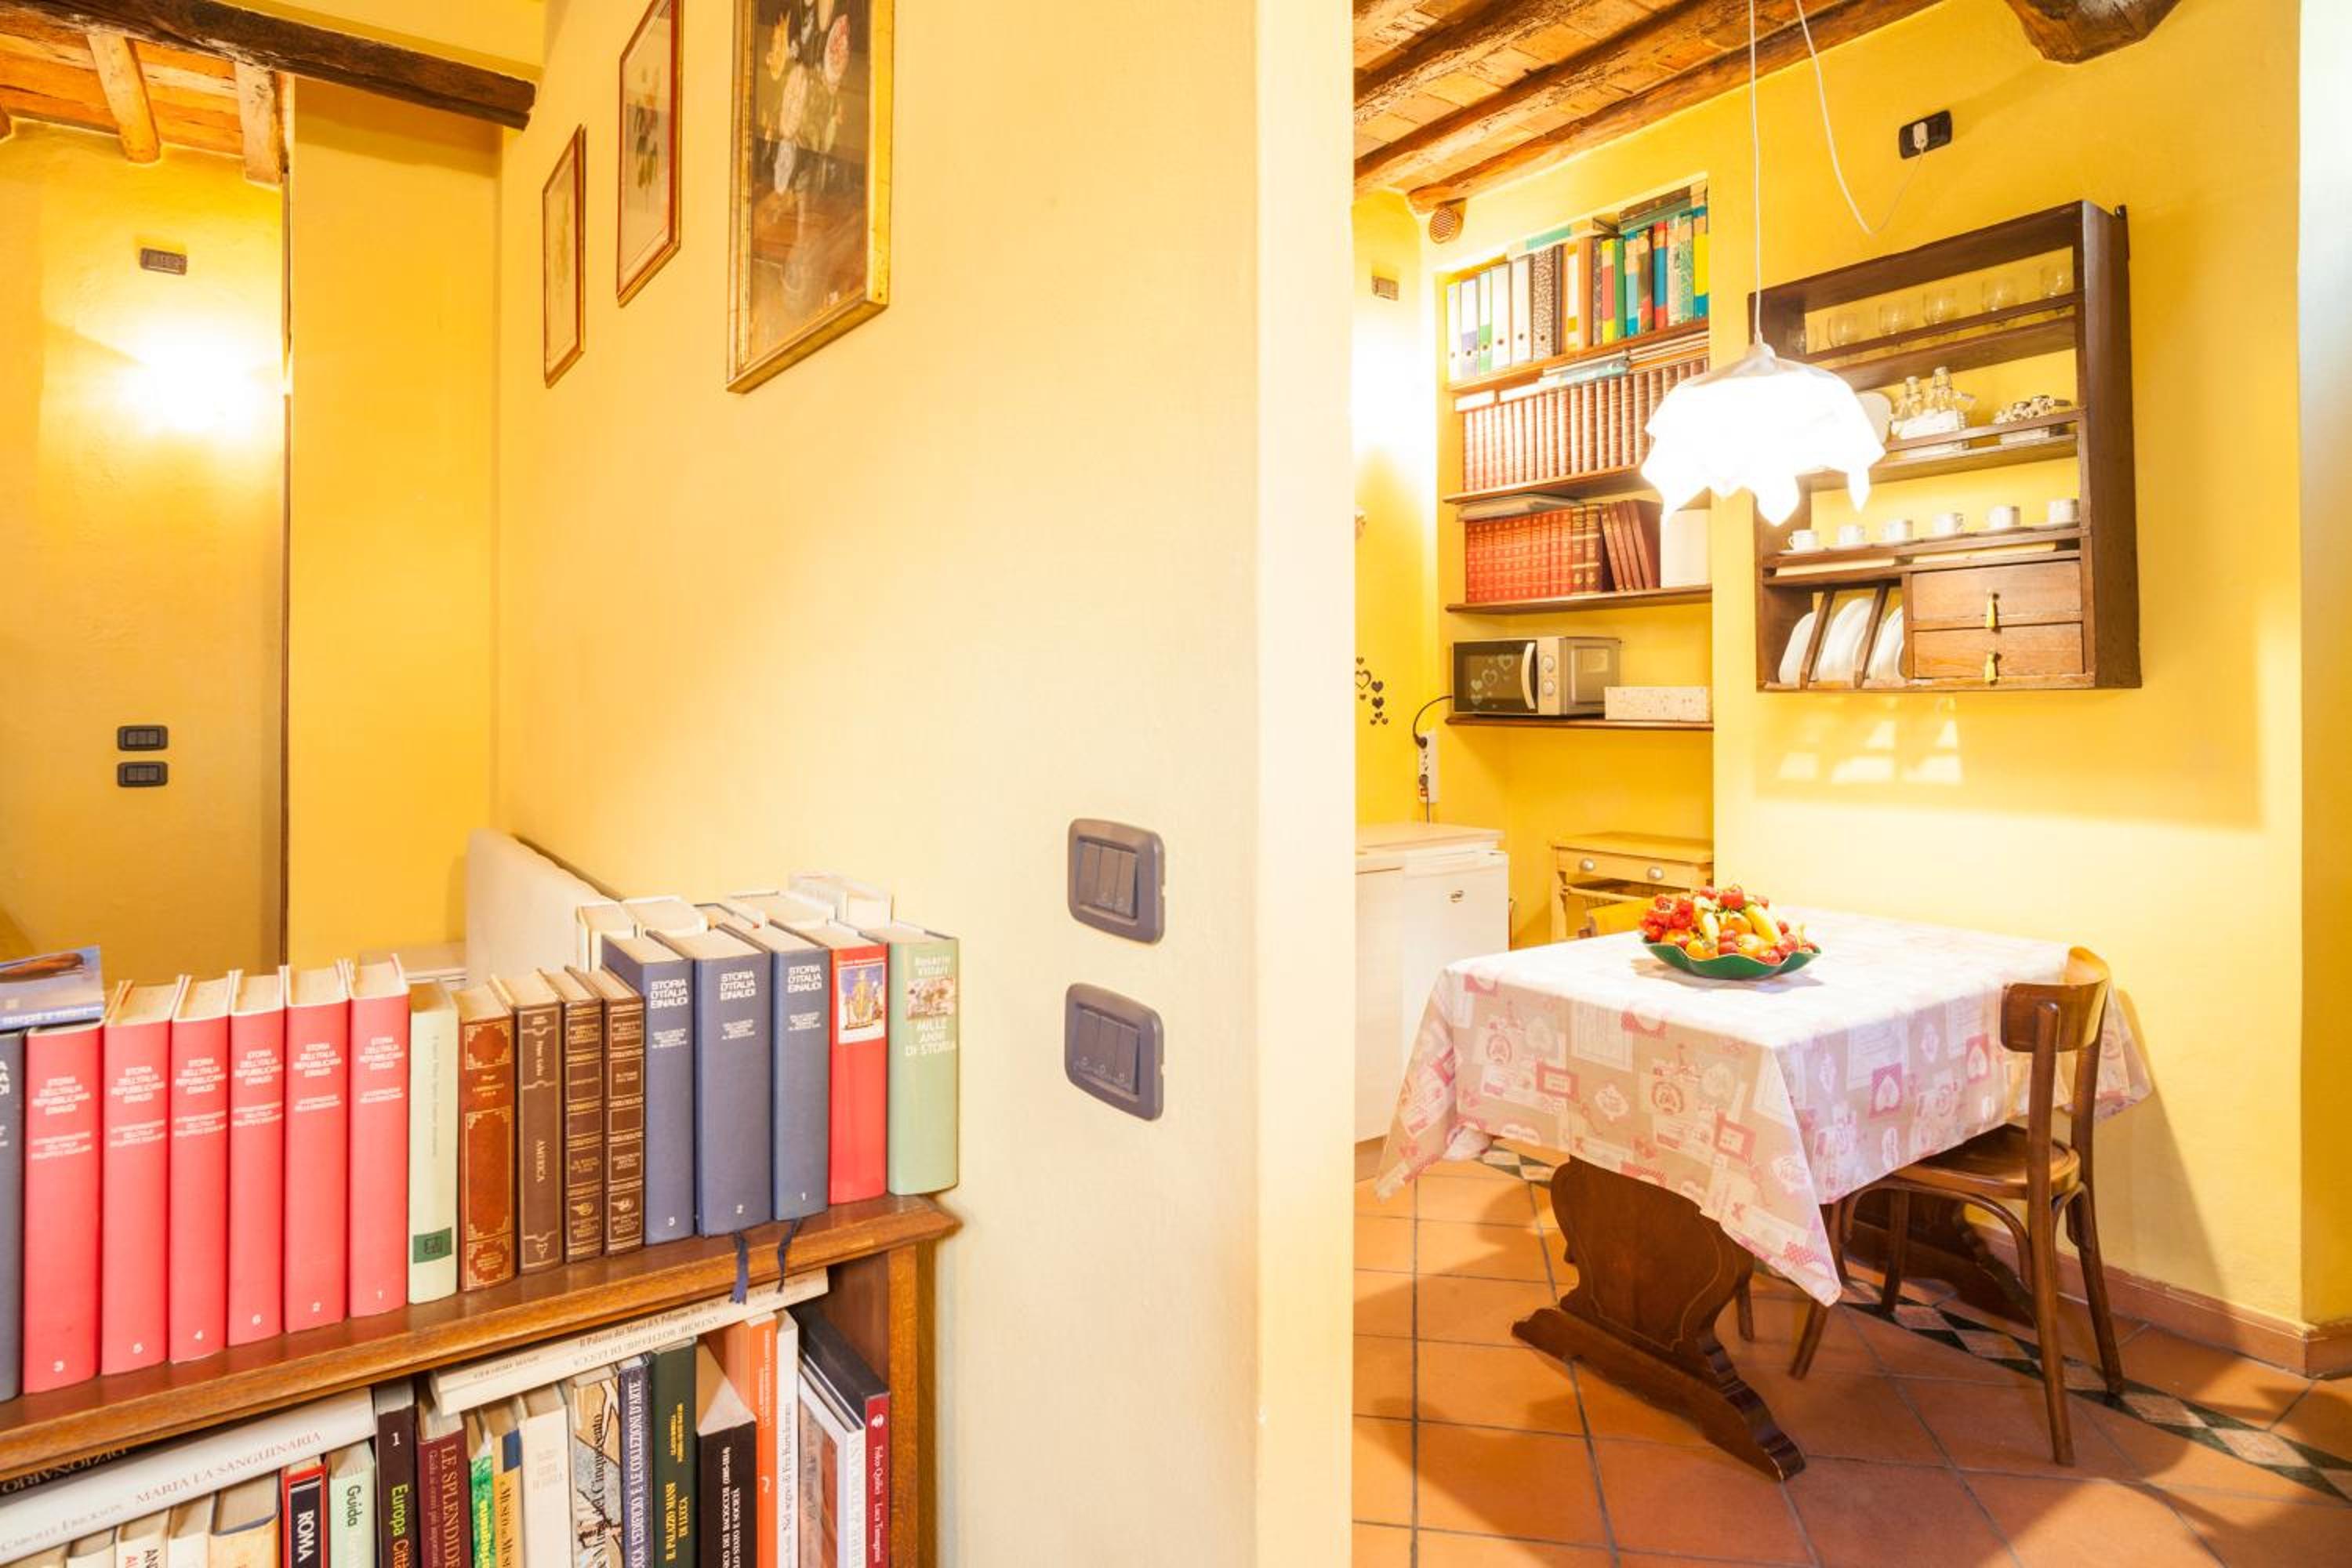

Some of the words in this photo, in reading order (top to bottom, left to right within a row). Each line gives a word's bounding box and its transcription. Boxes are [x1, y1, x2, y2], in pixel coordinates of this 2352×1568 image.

[651, 978, 687, 989] STORIA
[720, 970, 754, 982] STORIA
[788, 964, 821, 975] STORIA
[391, 1432, 401, 1446] 1
[441, 1443, 458, 1470] LE
[590, 1414, 606, 1494] Cinquecento
[136, 1475, 189, 1504] MARIA
[217, 1431, 322, 1477] SANGUINARIA
[347, 1484, 363, 1528] Guida
[390, 1483, 408, 1537] Europa
[441, 1472, 461, 1568] SPLENDIDE
[296, 1509, 314, 1563] ROMA
